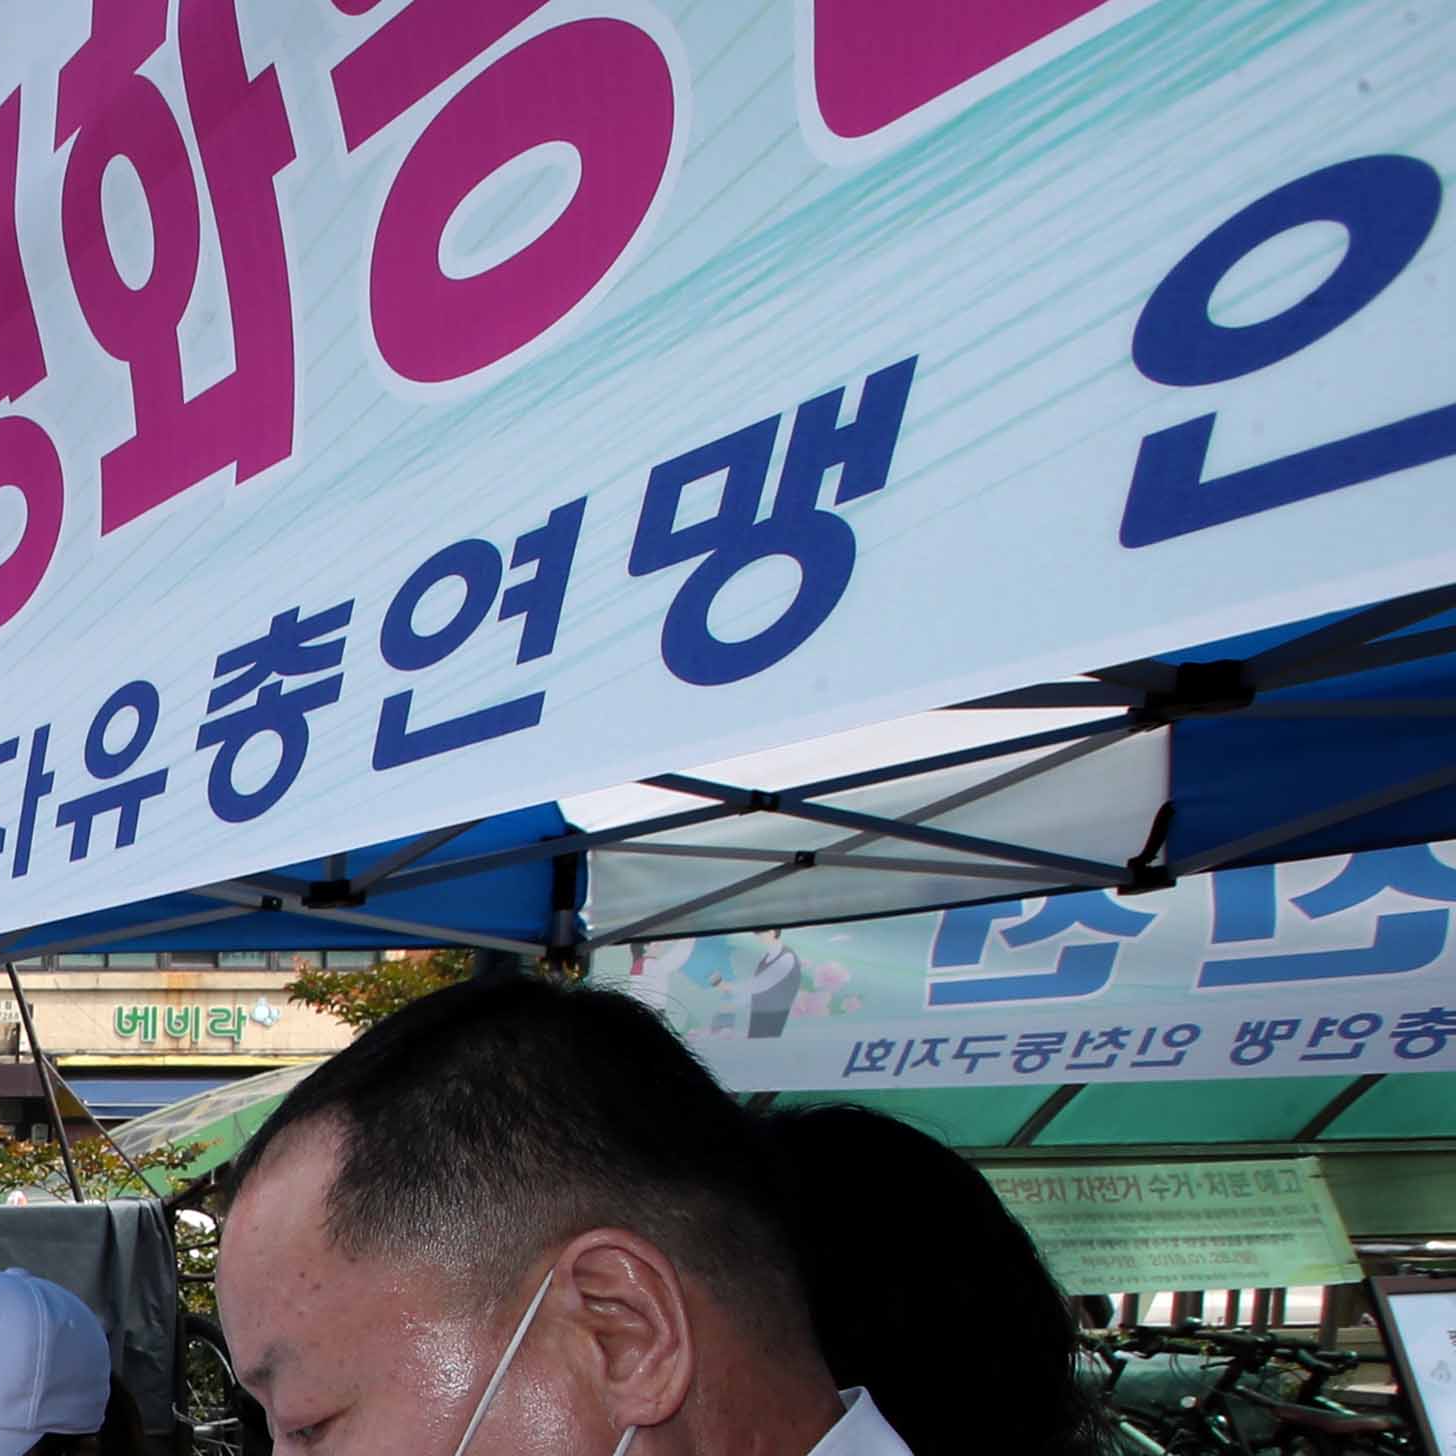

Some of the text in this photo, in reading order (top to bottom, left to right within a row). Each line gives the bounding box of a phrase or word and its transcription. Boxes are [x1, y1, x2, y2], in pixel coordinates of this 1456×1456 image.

[114, 1003, 248, 1043] 베비라
[1074, 1174, 1142, 1203] 자전거
[1253, 1168, 1304, 1195] 예고
